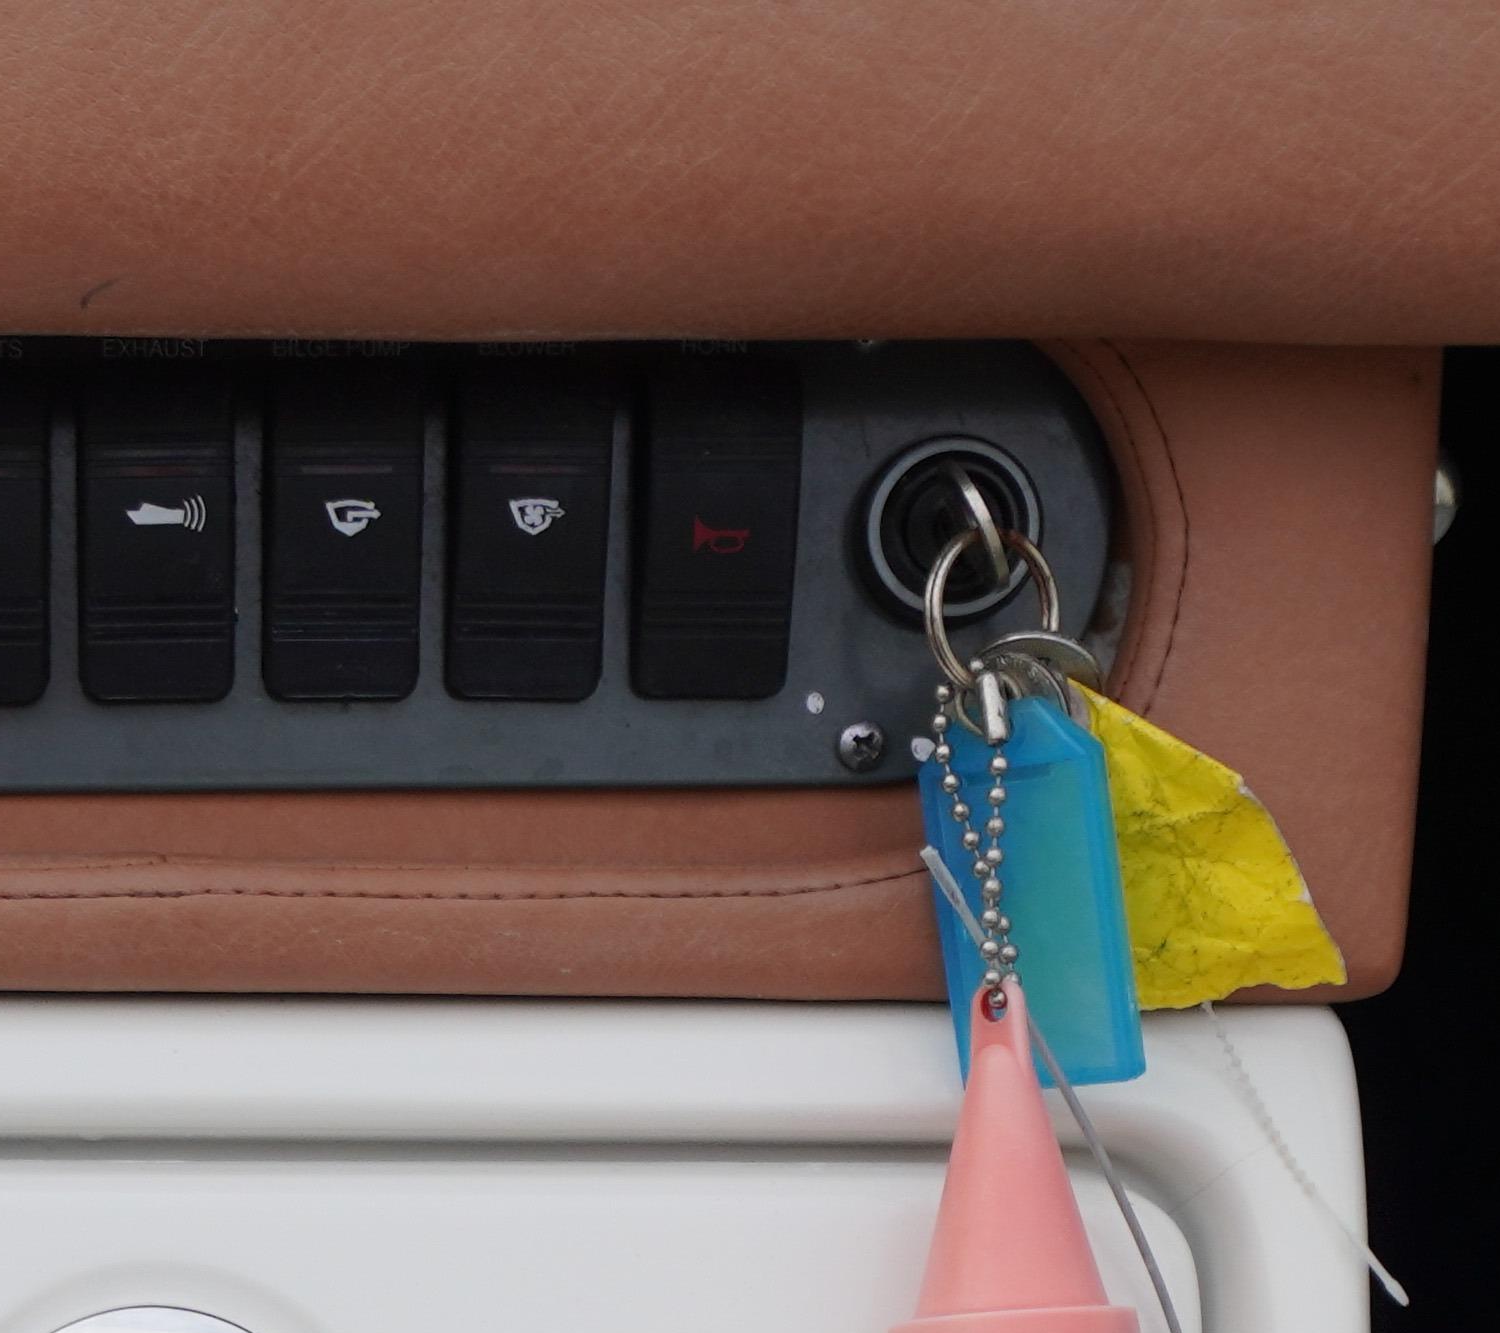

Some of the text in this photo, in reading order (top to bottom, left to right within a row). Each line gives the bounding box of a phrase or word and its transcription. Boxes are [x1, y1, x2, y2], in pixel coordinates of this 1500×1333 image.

[102, 338, 208, 358] EXHAUST
[272, 338, 411, 357] BILGE PUMP
[479, 340, 577, 356] BLOWER
